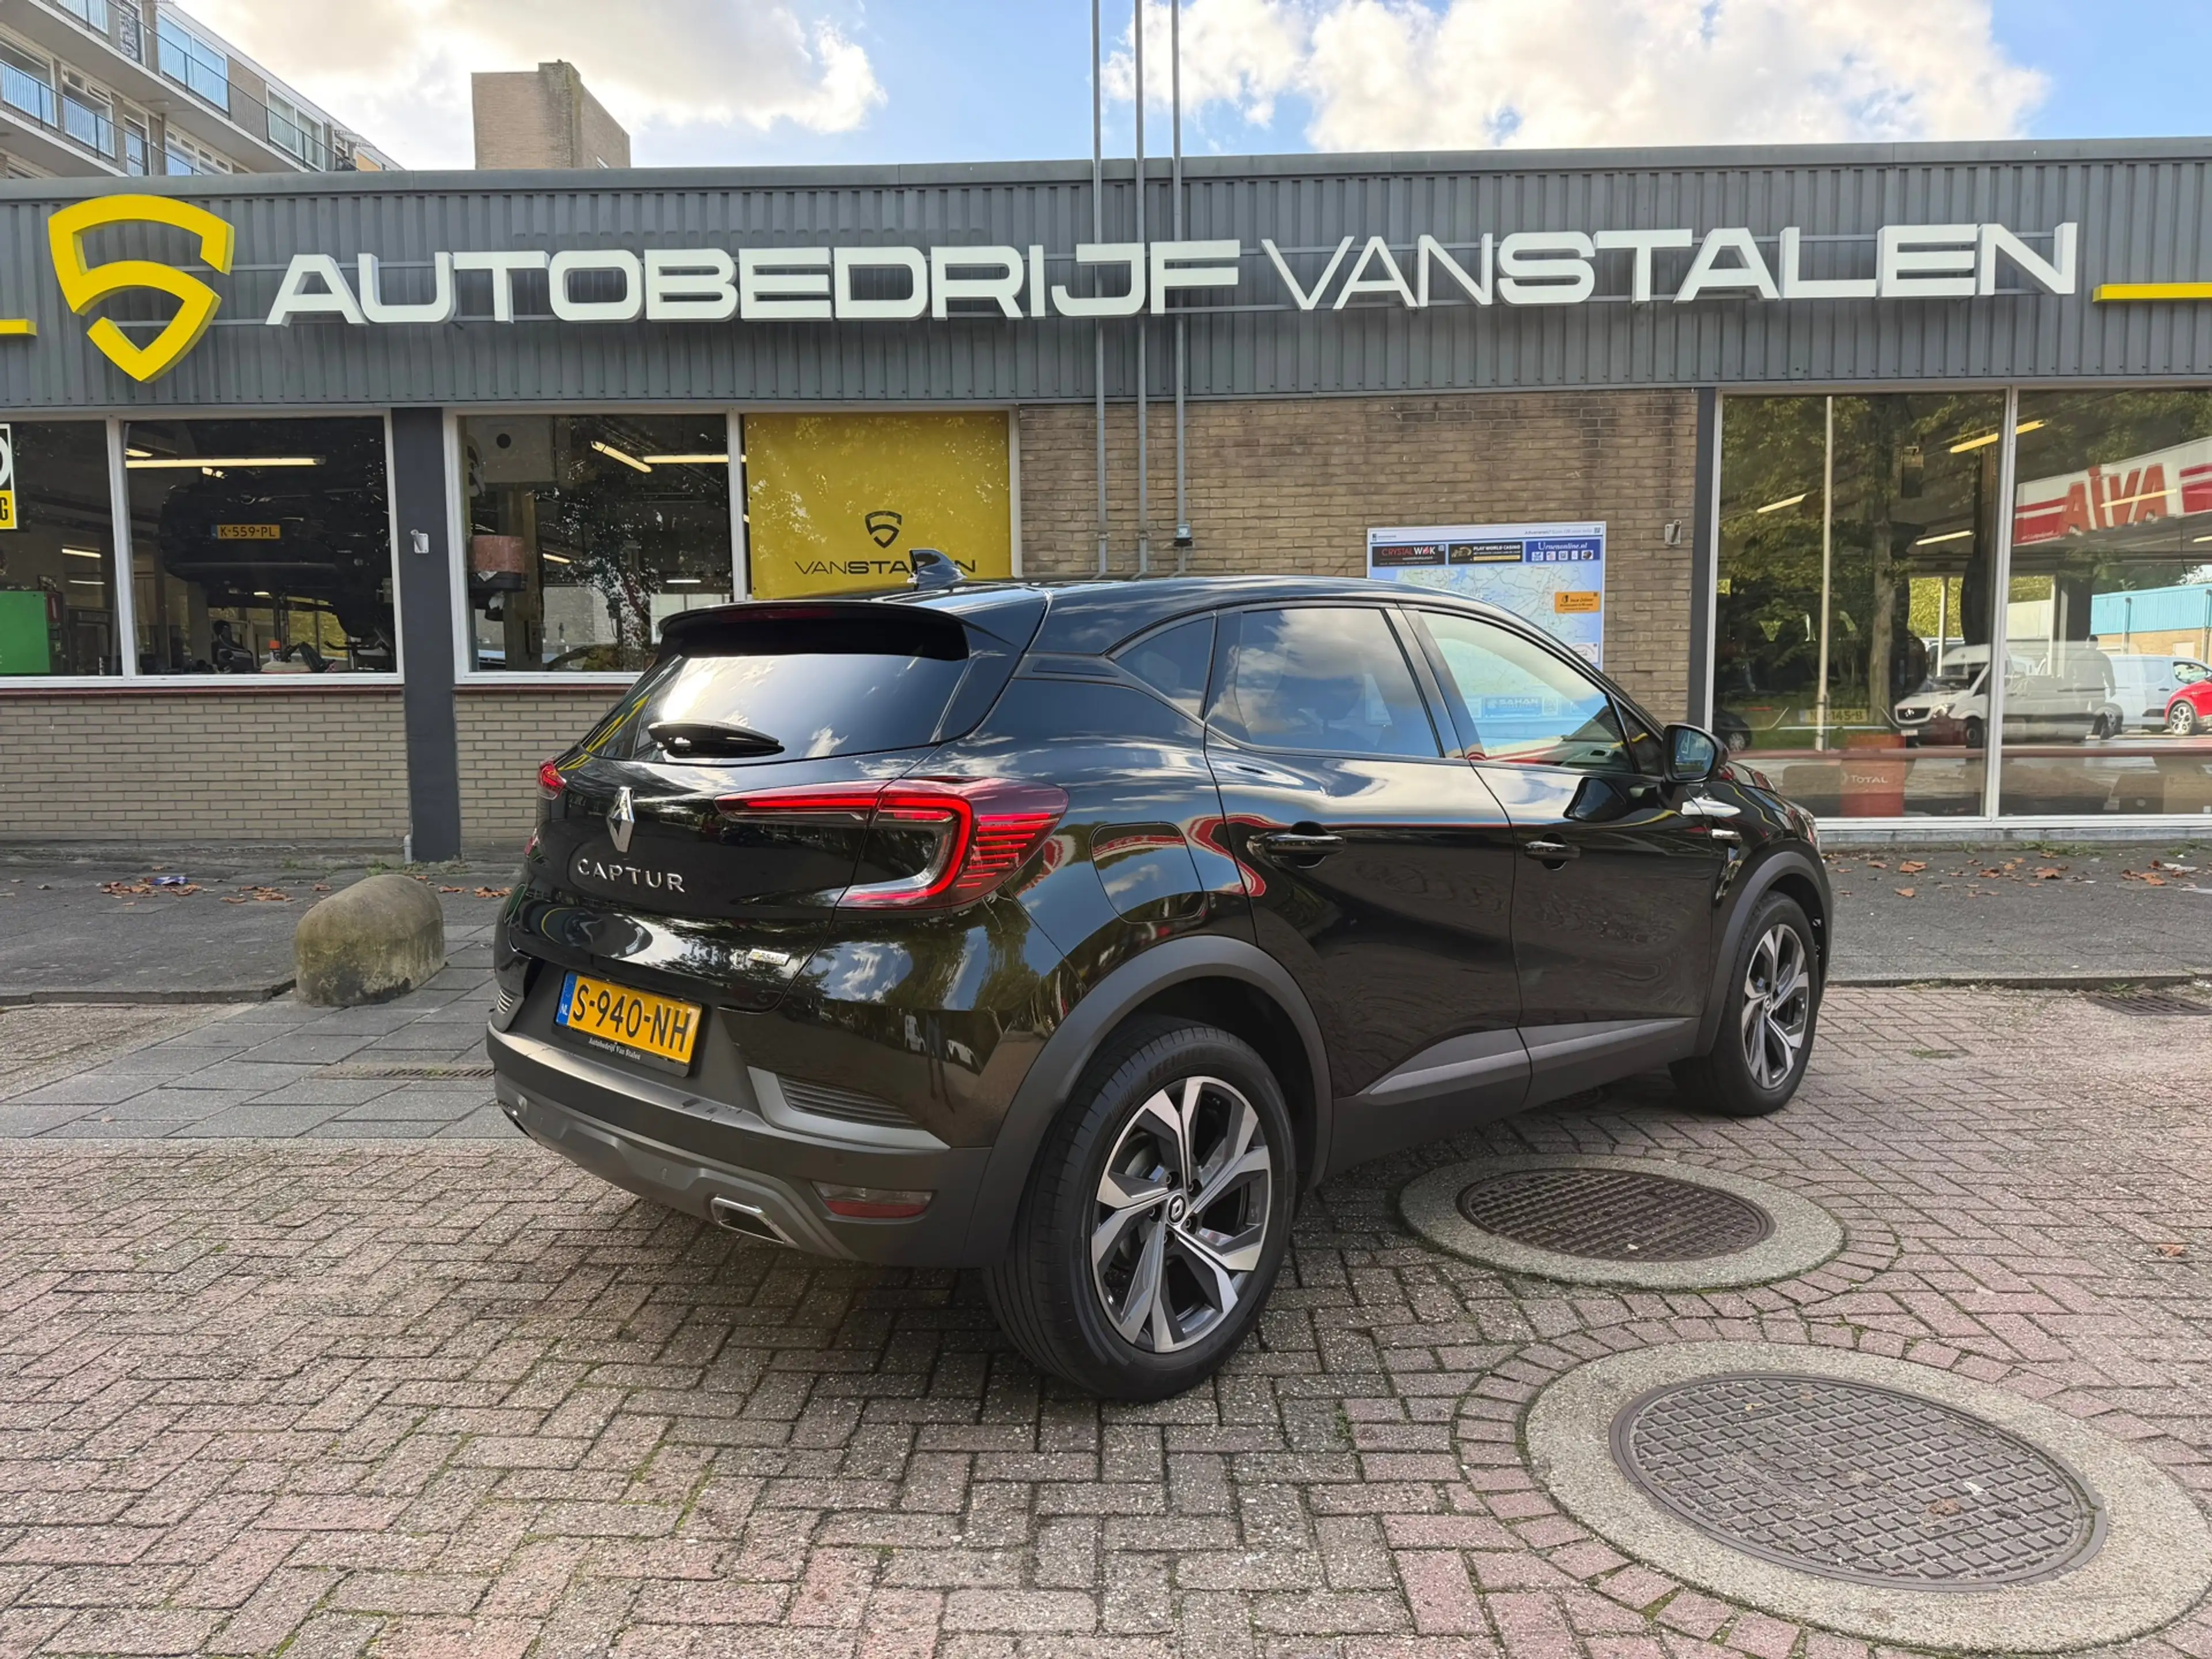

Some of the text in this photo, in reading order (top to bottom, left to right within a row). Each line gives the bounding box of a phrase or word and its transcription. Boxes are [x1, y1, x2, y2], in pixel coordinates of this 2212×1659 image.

[266, 240, 1240, 326] AUTOBEDRIJF
[220, 527, 275, 537] K-559-PL
[1381, 547, 1413, 556] CRYSTAL
[1850, 775, 1888, 783] TOTAL
[577, 858, 685, 893] CAPTUR
[560, 984, 692, 1053] NL S-940-NH
